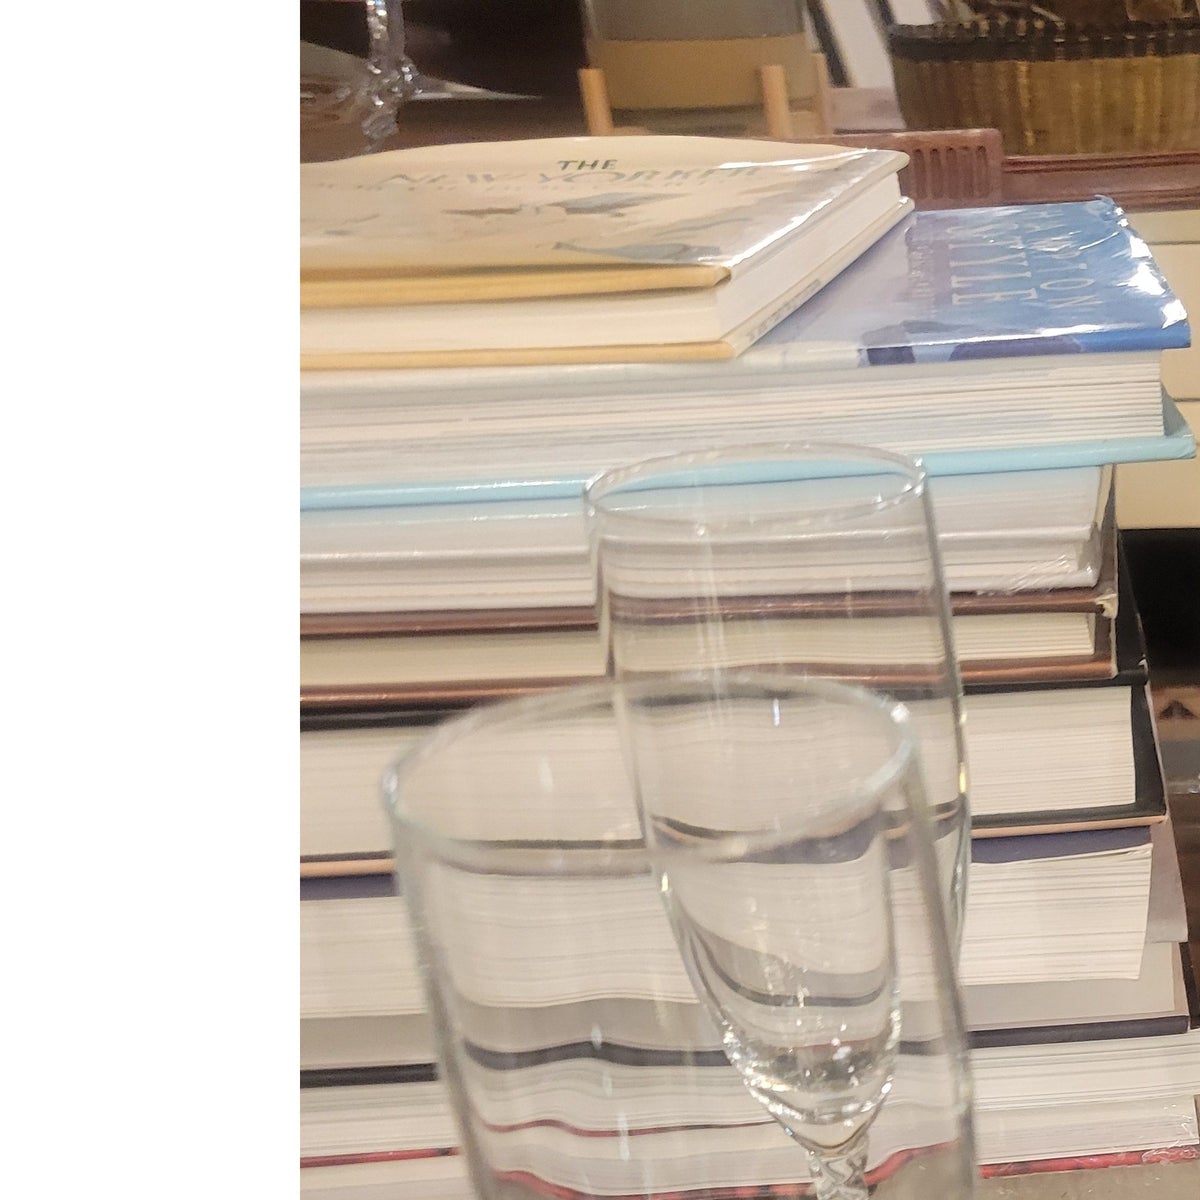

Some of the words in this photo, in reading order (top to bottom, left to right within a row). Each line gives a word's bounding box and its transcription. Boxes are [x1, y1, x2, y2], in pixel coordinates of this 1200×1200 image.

[378, 172, 526, 184] NEW
[538, 167, 761, 184] YORKER
[557, 159, 618, 171] THE
[945, 222, 1038, 306] STYLE
[1020, 209, 1104, 310] HAMPTON
